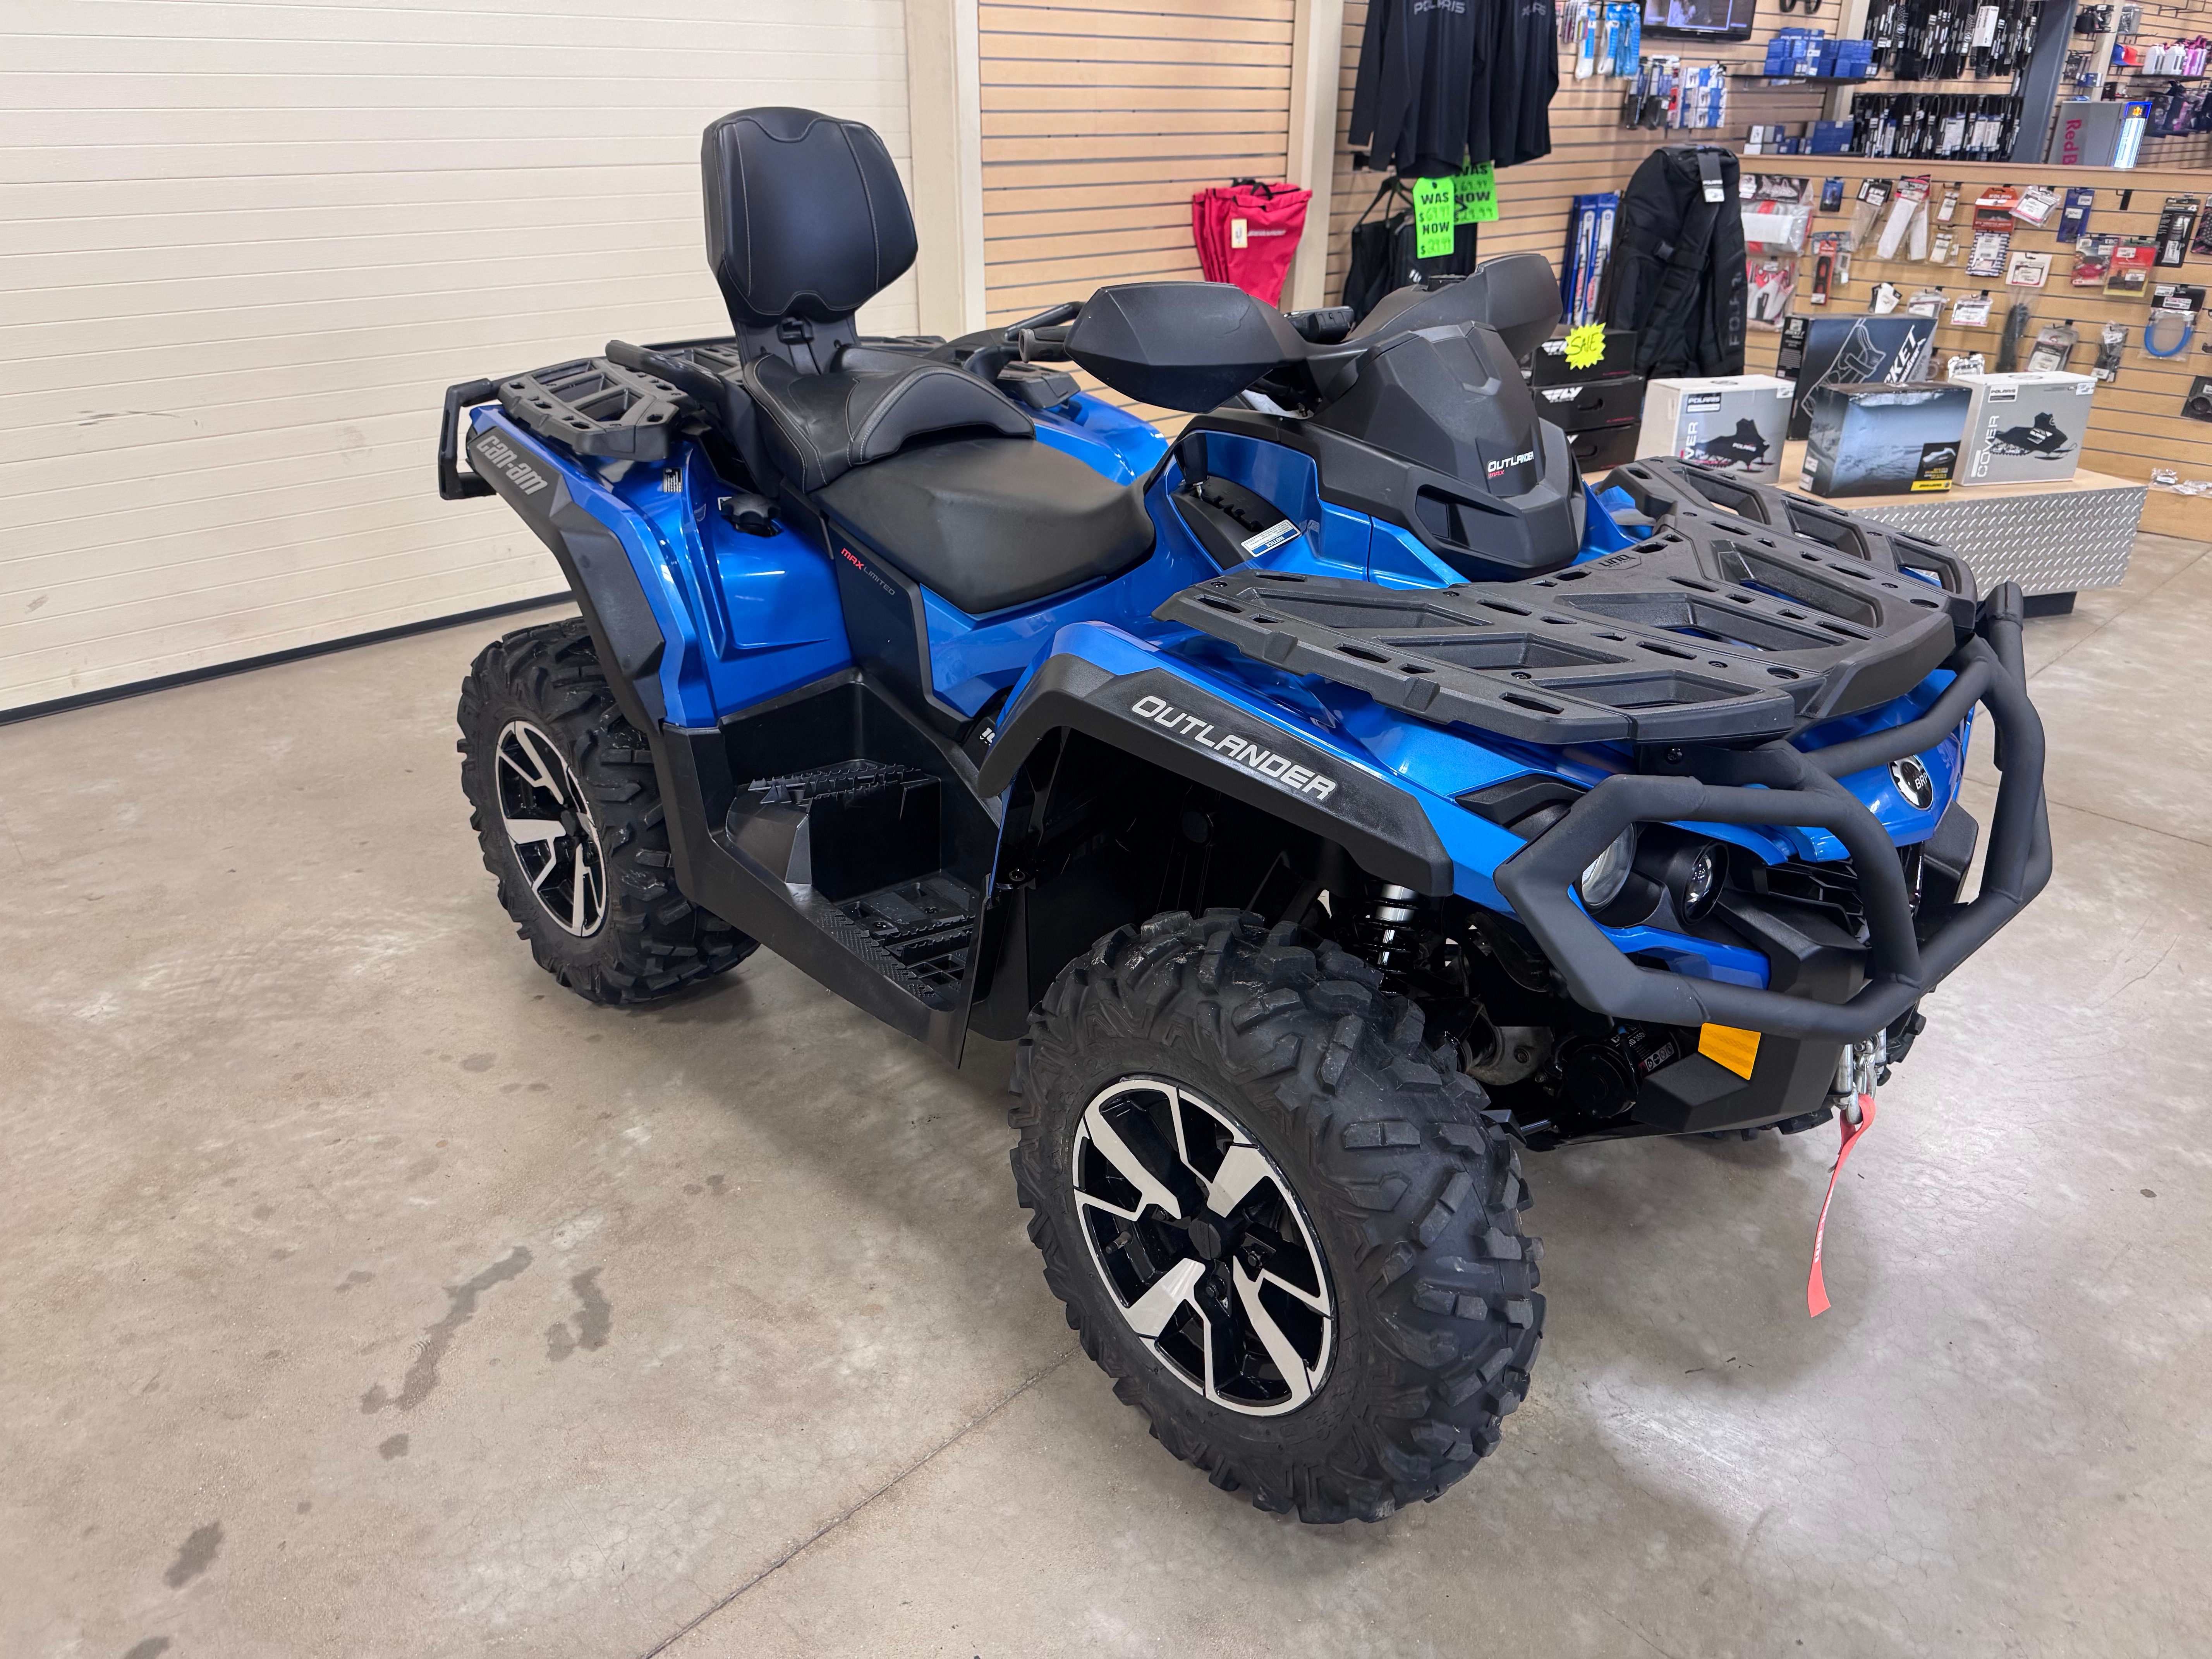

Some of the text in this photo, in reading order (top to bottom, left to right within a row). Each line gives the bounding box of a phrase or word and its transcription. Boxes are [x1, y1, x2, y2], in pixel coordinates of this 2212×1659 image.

[2064, 119, 2082, 151] Red
[1421, 192, 1449, 204] WAS
[1455, 192, 1490, 203] NOW
[1422, 222, 1449, 235] NOW
[1571, 332, 1599, 356] SALE
[1685, 421, 1698, 460] VER
[1977, 415, 1999, 477] COVER
[476, 435, 548, 495] can-am
[1488, 451, 1534, 472] OUTLANDER
[1265, 536, 1285, 548] NOTICE
[863, 567, 895, 596] LIMITED
[1132, 696, 1337, 800] OUTLANDER
[1915, 772, 1927, 790] BRP
